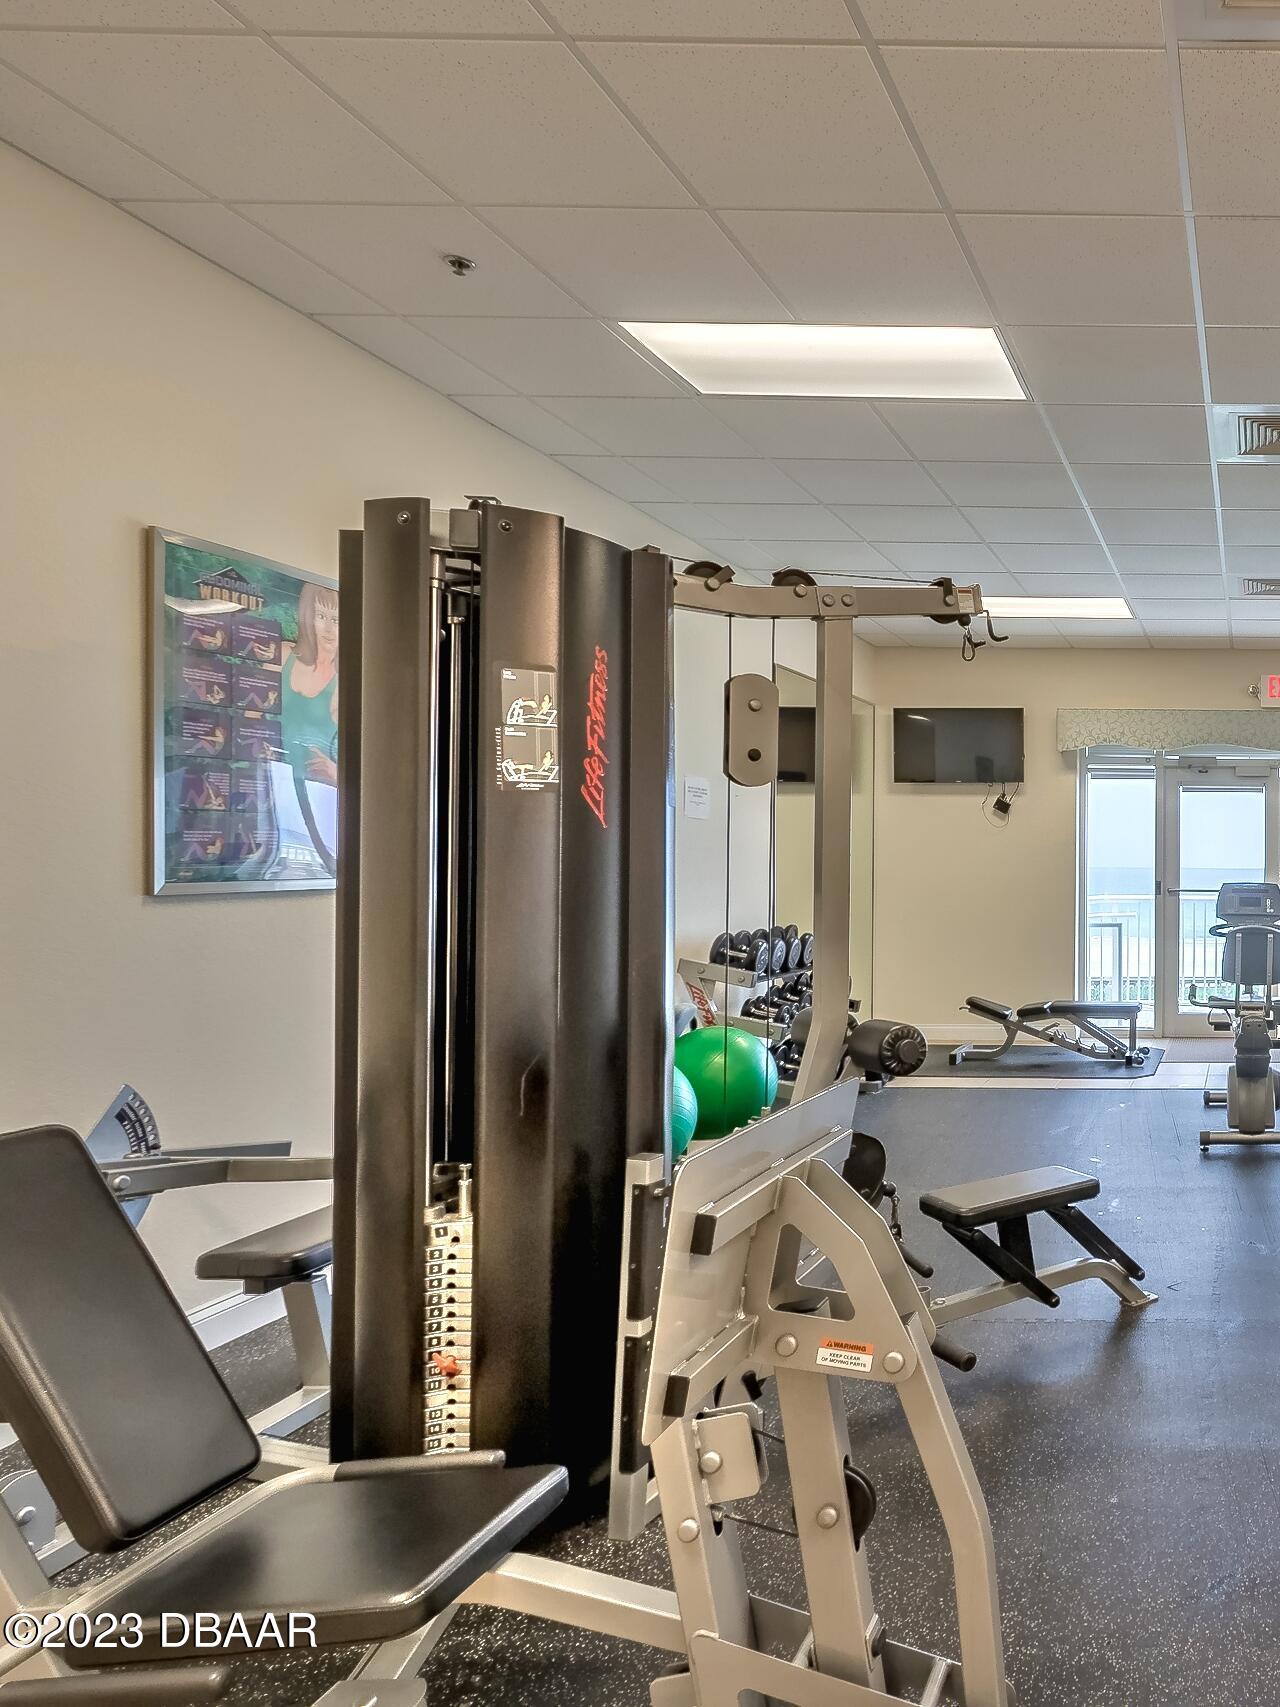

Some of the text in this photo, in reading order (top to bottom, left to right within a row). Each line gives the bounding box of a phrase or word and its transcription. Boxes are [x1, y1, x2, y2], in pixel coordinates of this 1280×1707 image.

[200, 584, 265, 612] WORKOUT
[833, 1340, 867, 1353] WARNING
[829, 1358, 849, 1366] MOVING
